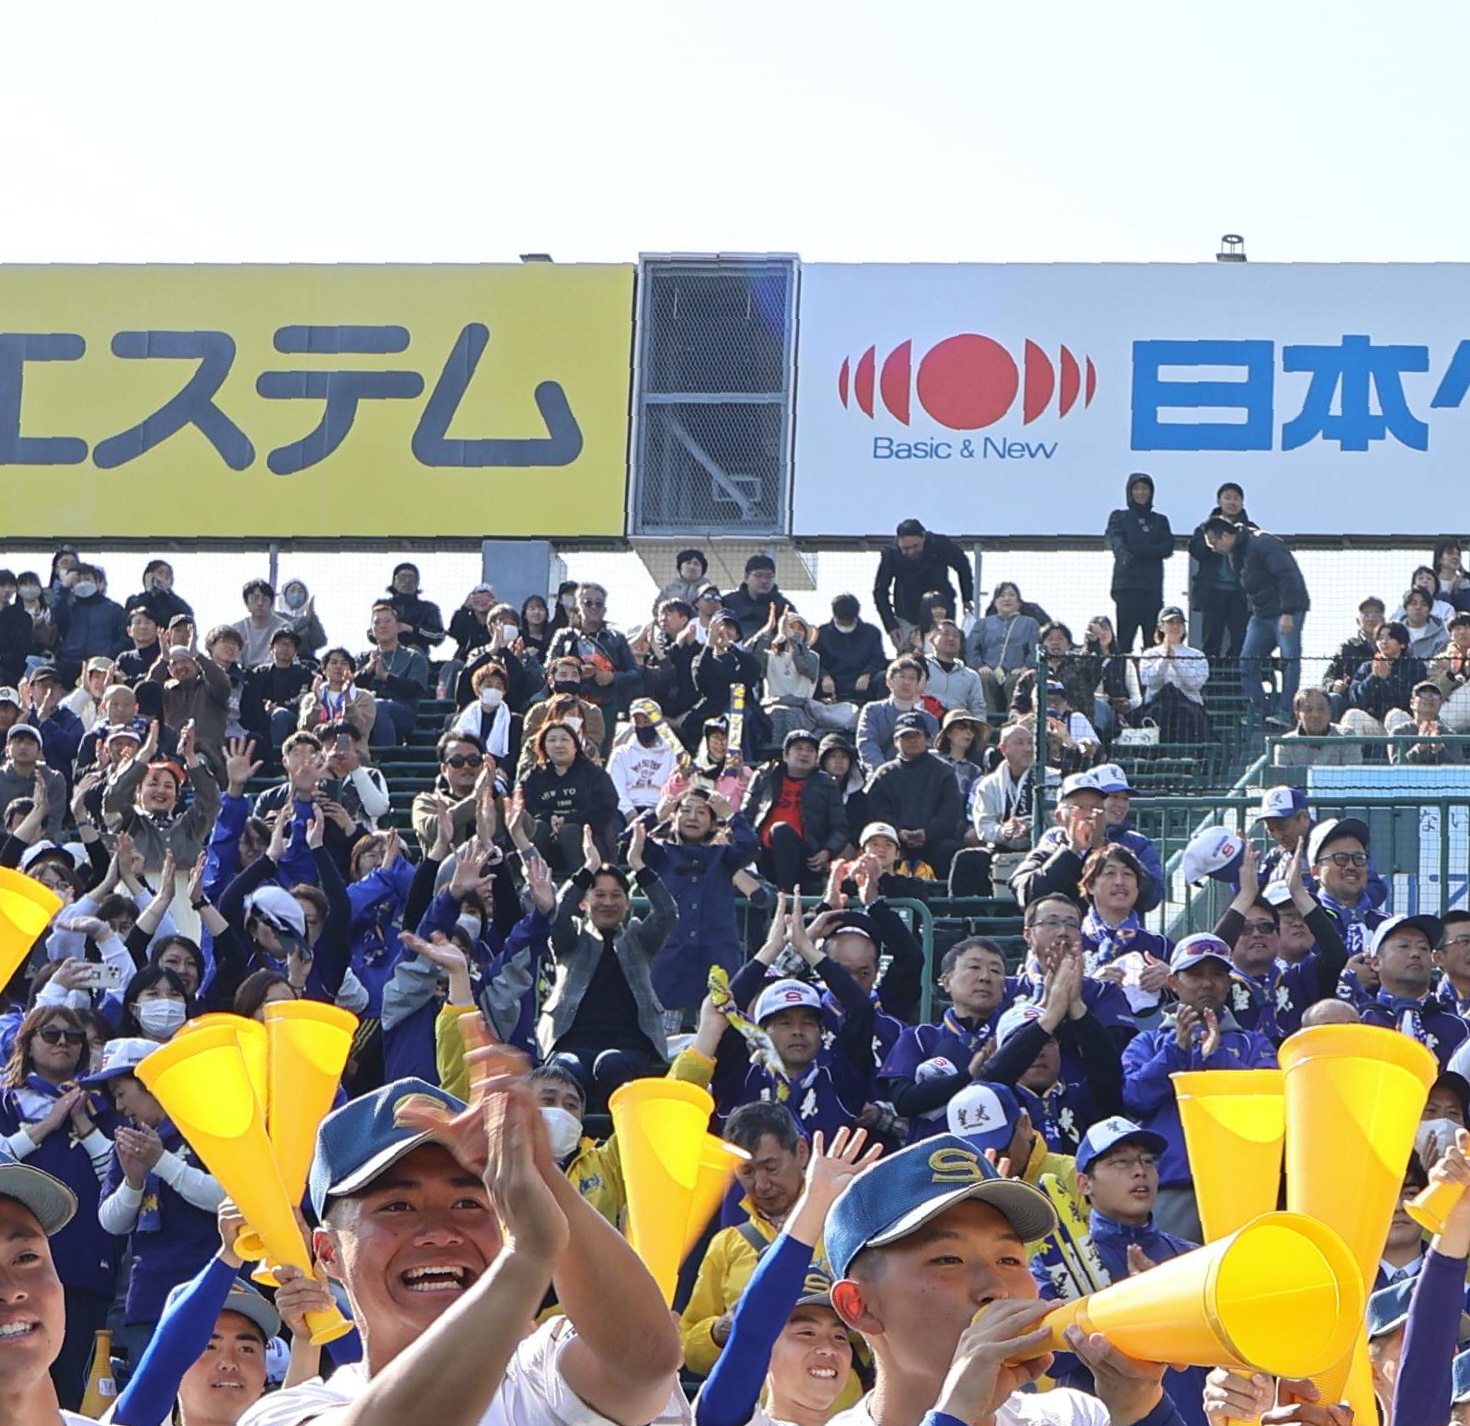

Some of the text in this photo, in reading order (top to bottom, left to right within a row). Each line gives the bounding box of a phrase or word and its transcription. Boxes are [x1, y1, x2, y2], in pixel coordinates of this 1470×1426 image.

[0, 323, 584, 476] エステム
[873, 436, 1058, 462] Basic & New
[928, 1147, 984, 1184] S
[803, 1273, 833, 1297] S
